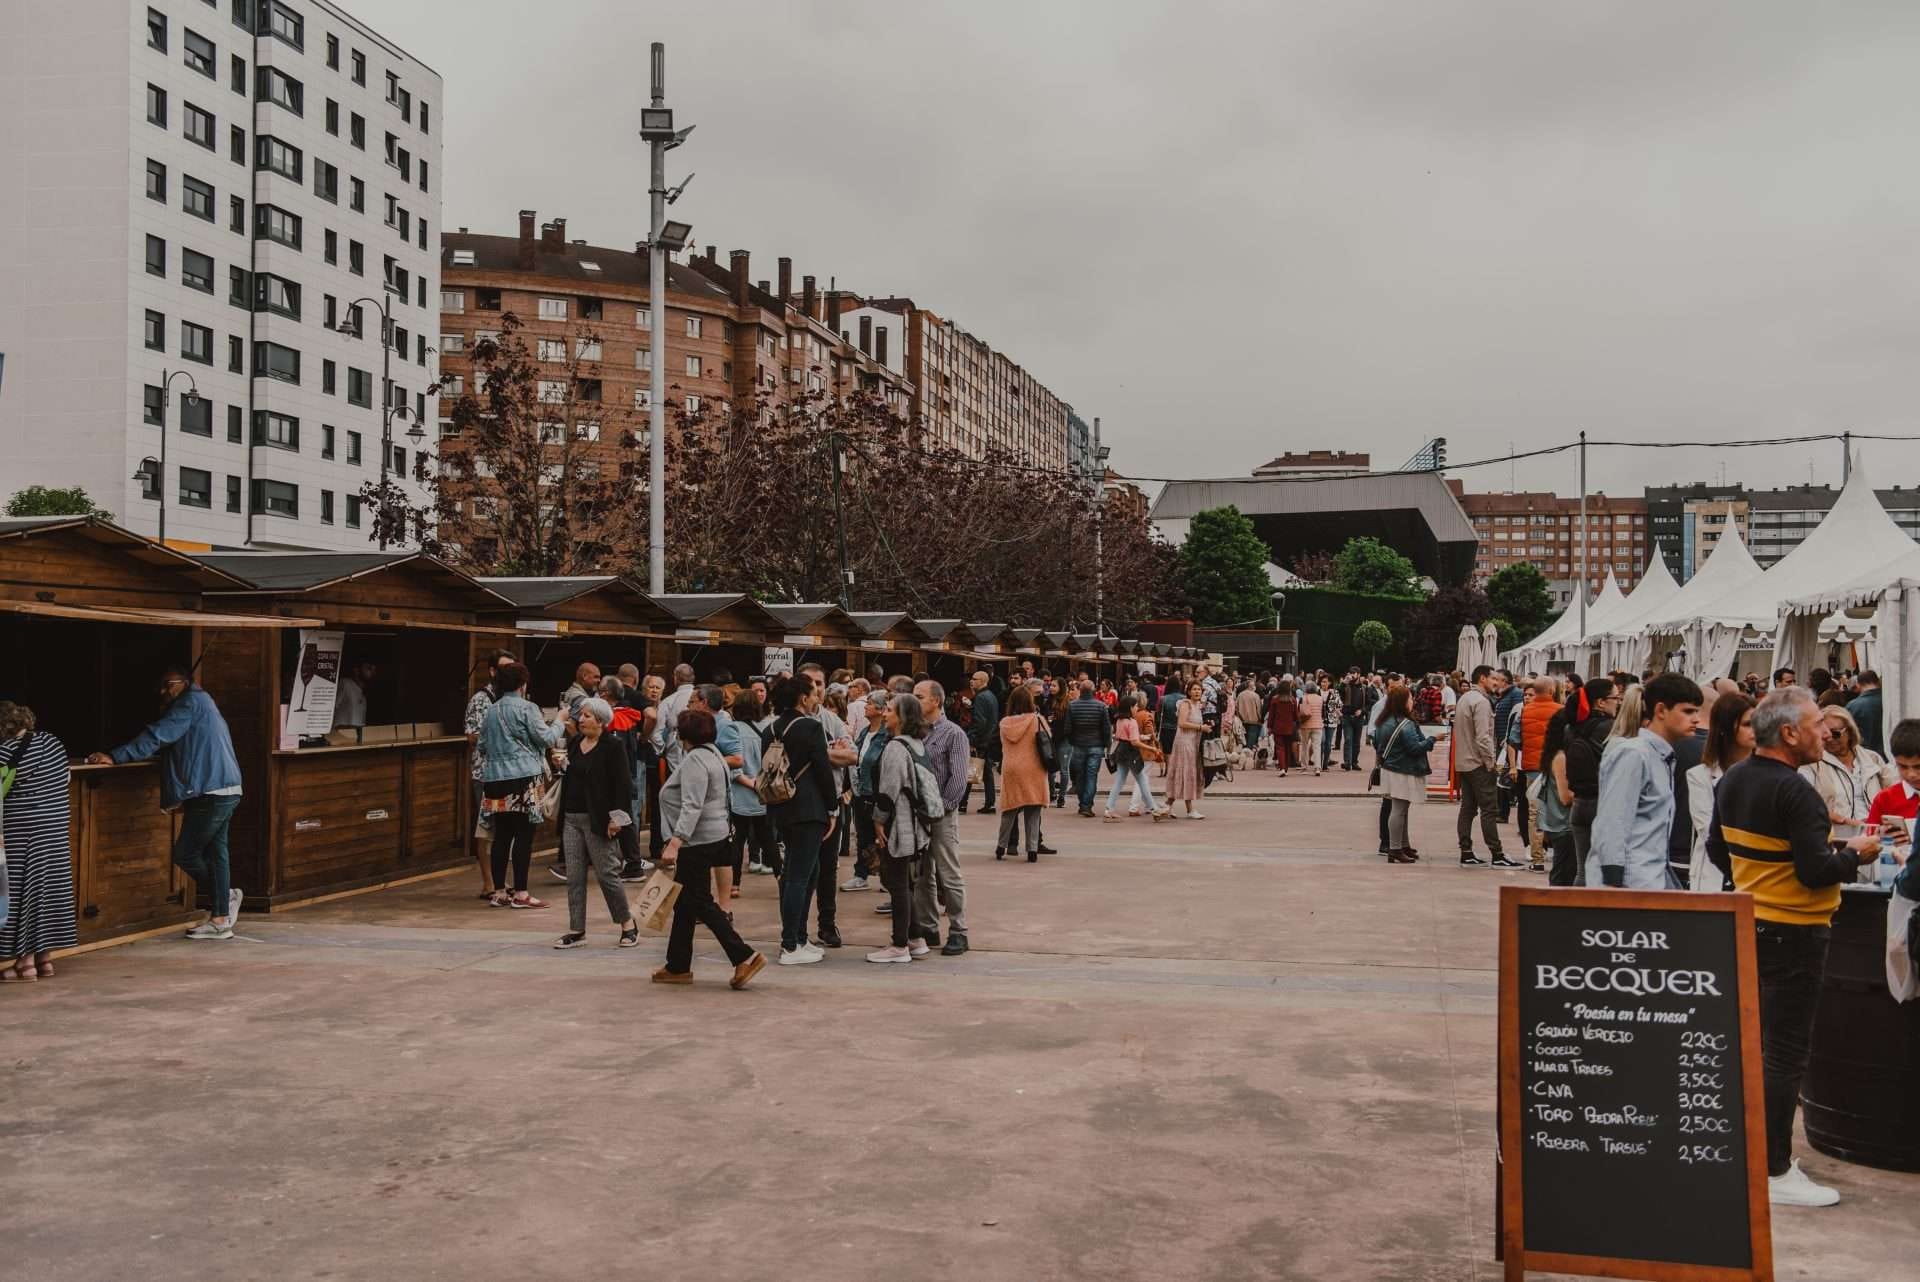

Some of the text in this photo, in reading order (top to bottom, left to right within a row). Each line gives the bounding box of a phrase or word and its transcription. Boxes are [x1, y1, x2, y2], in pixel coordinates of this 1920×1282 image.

[1581, 929, 1670, 949] SOLAR
[1610, 952, 1637, 963] DE
[1534, 964, 1722, 996] BECQUER
[1617, 1010, 1634, 1021] en
[1636, 1007, 1651, 1022] tu
[1582, 1023, 1634, 1043] VERDEJO
[1678, 1073, 1724, 1088] 3,50€
[1533, 1081, 1723, 1110] CAVA 3,00€
[1534, 1104, 1574, 1123] TORO
[1679, 1115, 1731, 1134] 2,50€
[1536, 1131, 1590, 1152] RIBERA
[1678, 1145, 1732, 1164] 2,50€
